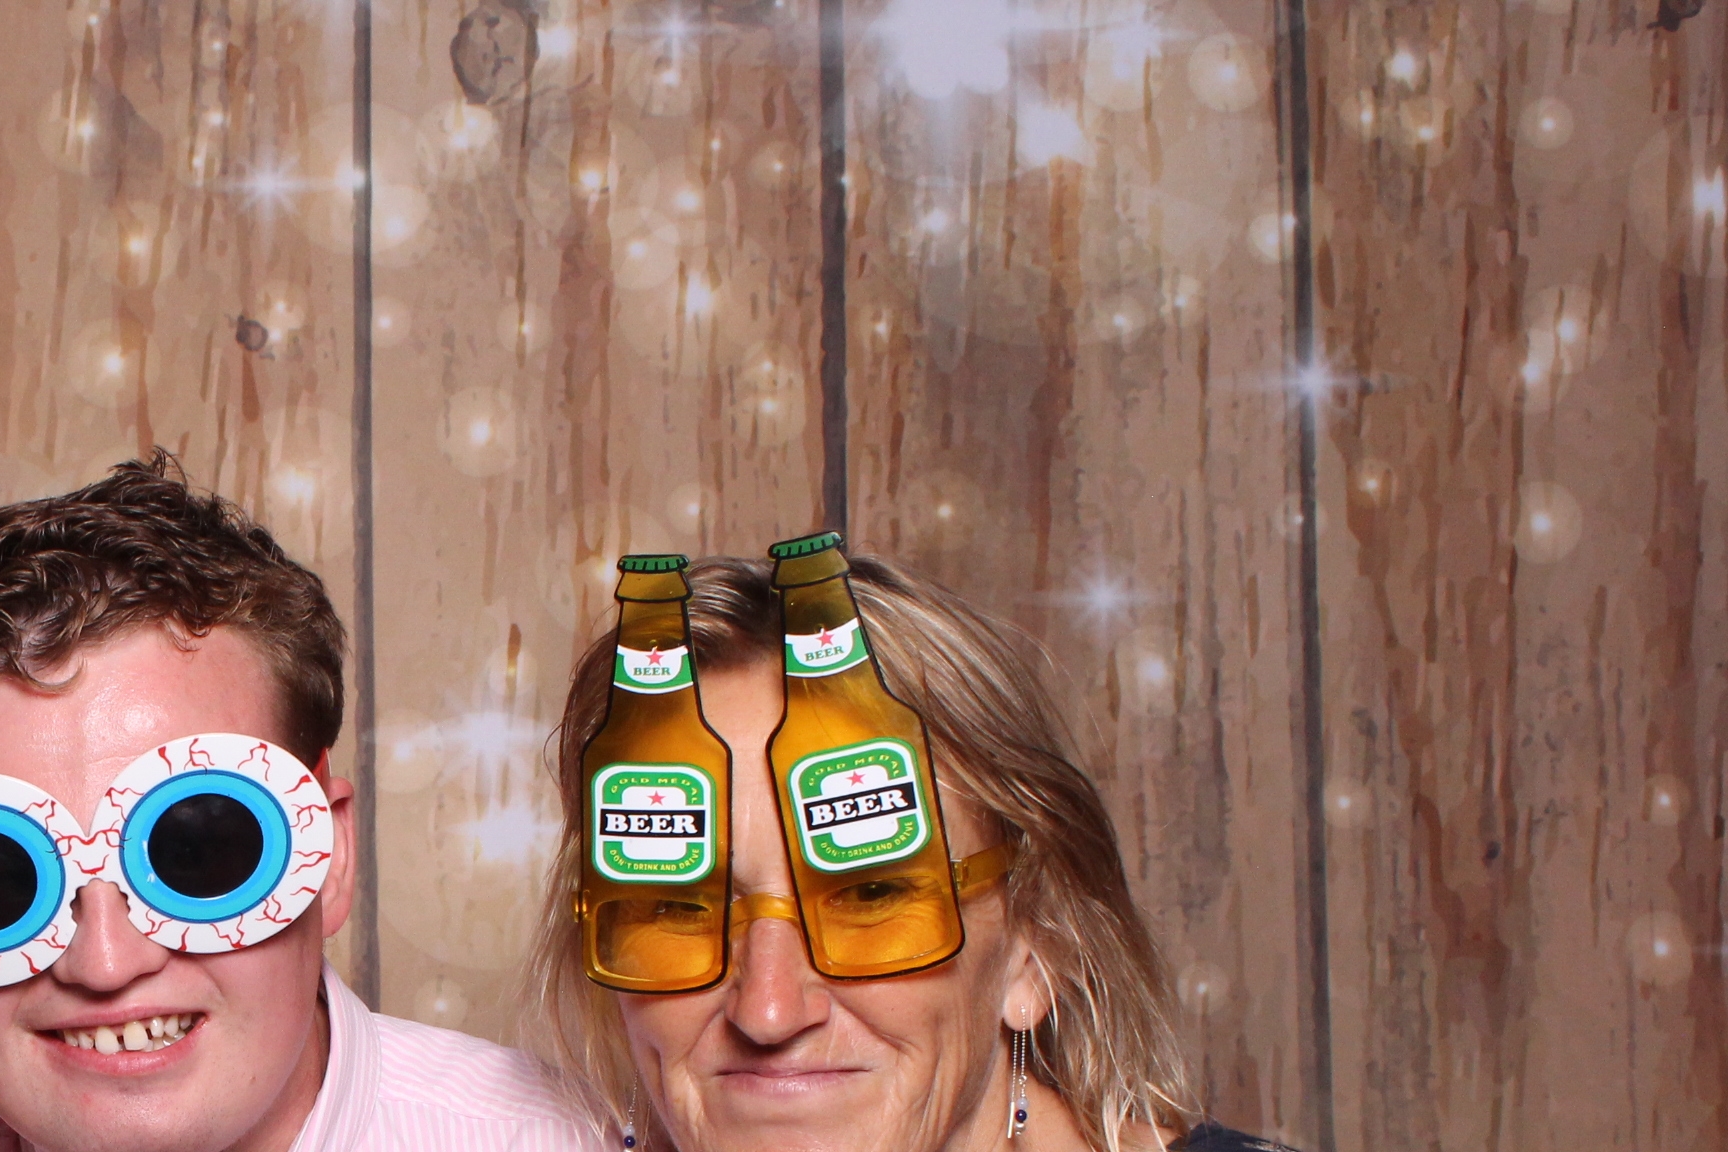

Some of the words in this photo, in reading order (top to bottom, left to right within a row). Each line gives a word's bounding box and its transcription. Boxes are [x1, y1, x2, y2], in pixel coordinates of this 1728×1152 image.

[805, 645, 844, 661] BEER
[633, 667, 671, 676] BEER
[808, 763, 846, 786] GOLD
[854, 754, 900, 777] MEDAL
[611, 777, 650, 793] GOLD
[657, 777, 698, 804] MEDAL
[808, 789, 909, 826] BEER
[604, 813, 698, 834] BEER
[820, 842, 846, 858] DON'T
[847, 847, 873, 857] DRINK
[875, 842, 893, 852] AND
[894, 821, 914, 846] DRIVE
[609, 849, 632, 869] DON'T
[633, 863, 659, 871] DRINK
[679, 849, 700, 869] DRIVE
